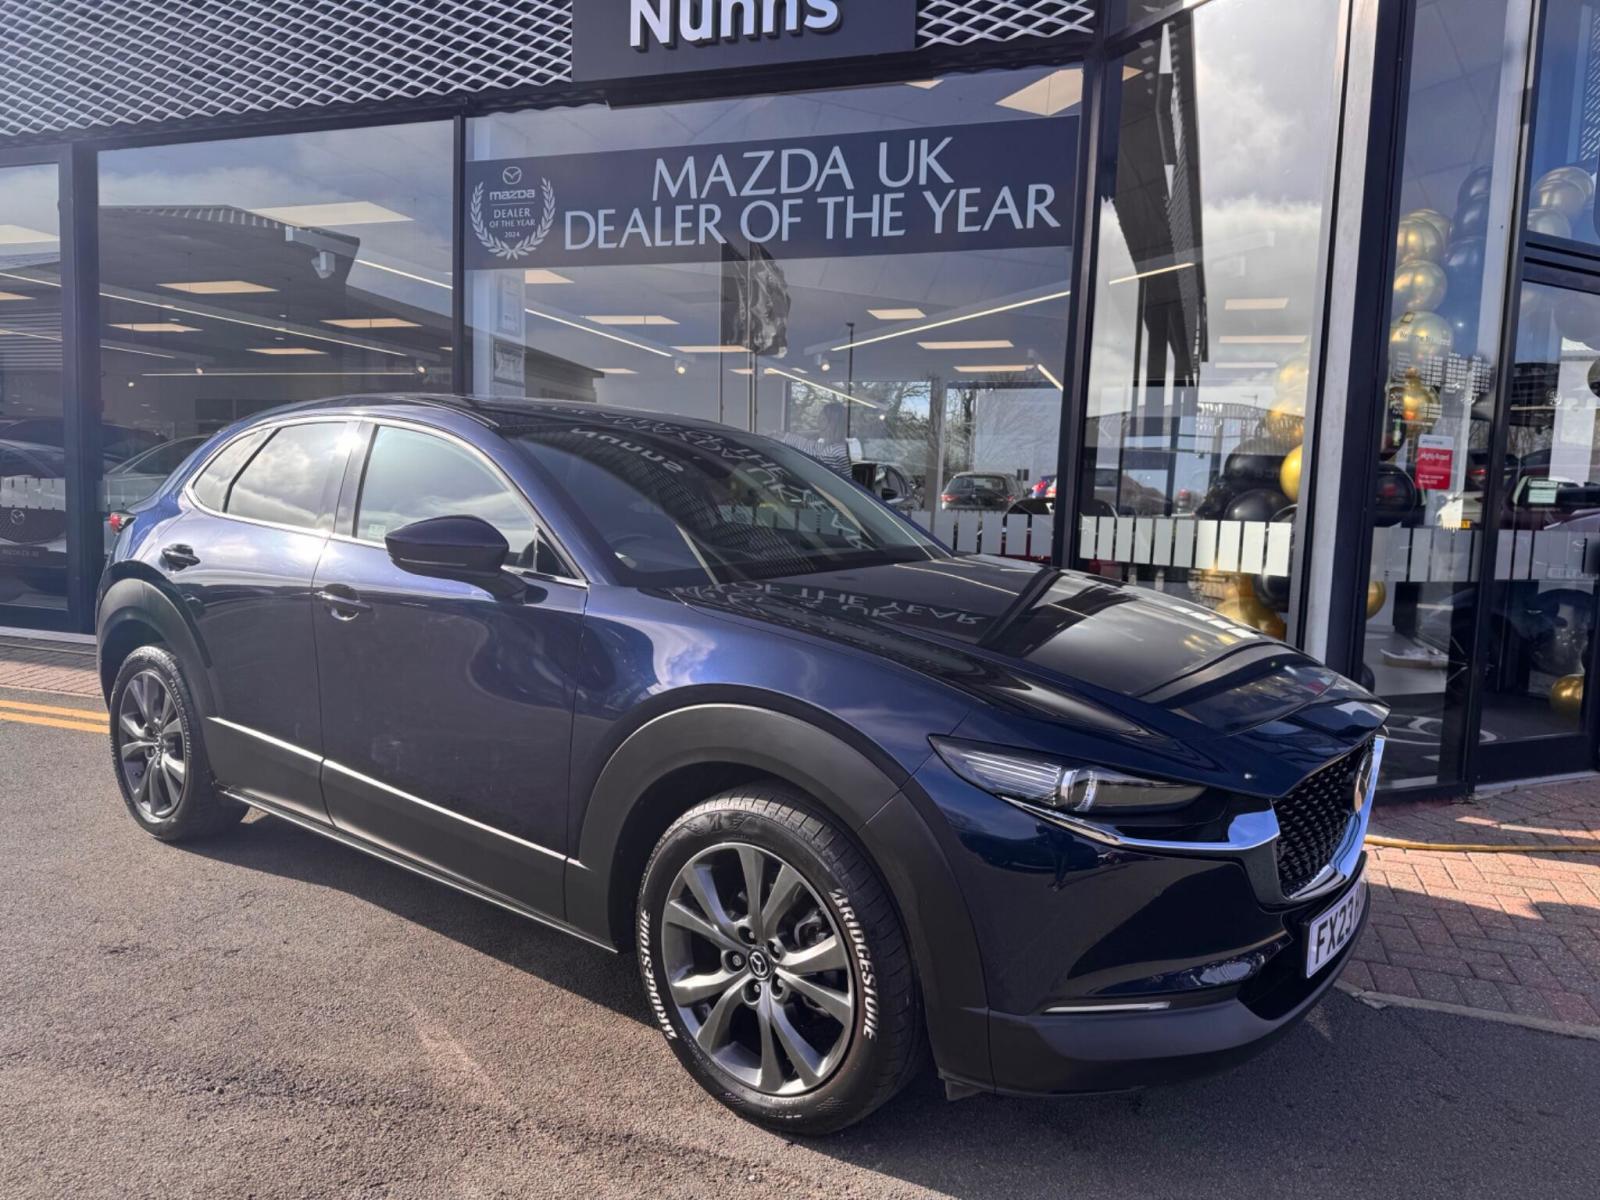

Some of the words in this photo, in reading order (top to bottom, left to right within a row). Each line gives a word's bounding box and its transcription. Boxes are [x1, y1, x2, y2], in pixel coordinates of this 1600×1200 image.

[630, 0, 839, 47] Nunns
[652, 143, 855, 201] MAZDA
[878, 136, 955, 188] UK
[489, 189, 536, 201] mazda
[493, 207, 531, 219] DEALER
[564, 203, 728, 250] DEALER
[740, 198, 804, 243] OF
[816, 192, 906, 240] THE
[922, 183, 1062, 235] YEAR
[489, 220, 499, 229] OF
[501, 219, 515, 228] THE
[517, 218, 536, 227] YEAR
[504, 230, 521, 239] 2024
